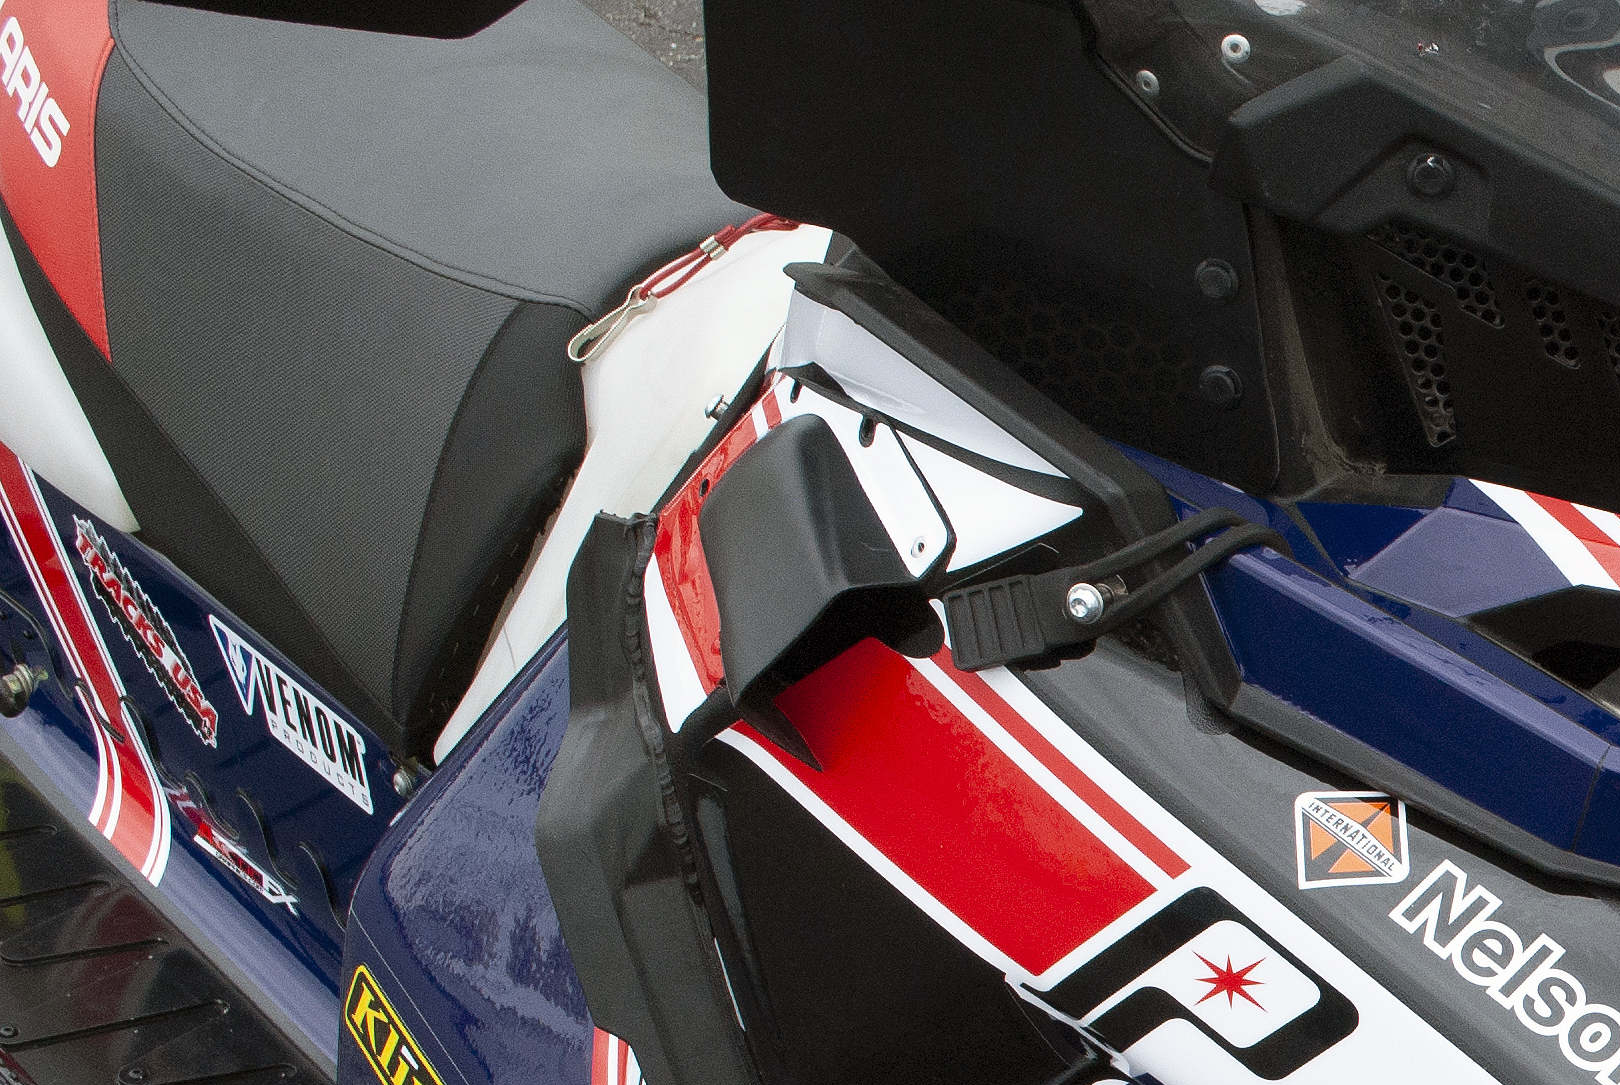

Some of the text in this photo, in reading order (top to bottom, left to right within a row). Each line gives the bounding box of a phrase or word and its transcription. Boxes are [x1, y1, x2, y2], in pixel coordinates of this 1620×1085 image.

[80, 532, 217, 734] TRACKS USA
[255, 656, 365, 788] VENOM
[271, 719, 370, 807] PRODUCTS
[1308, 802, 1396, 872] INTERNATIONAL
